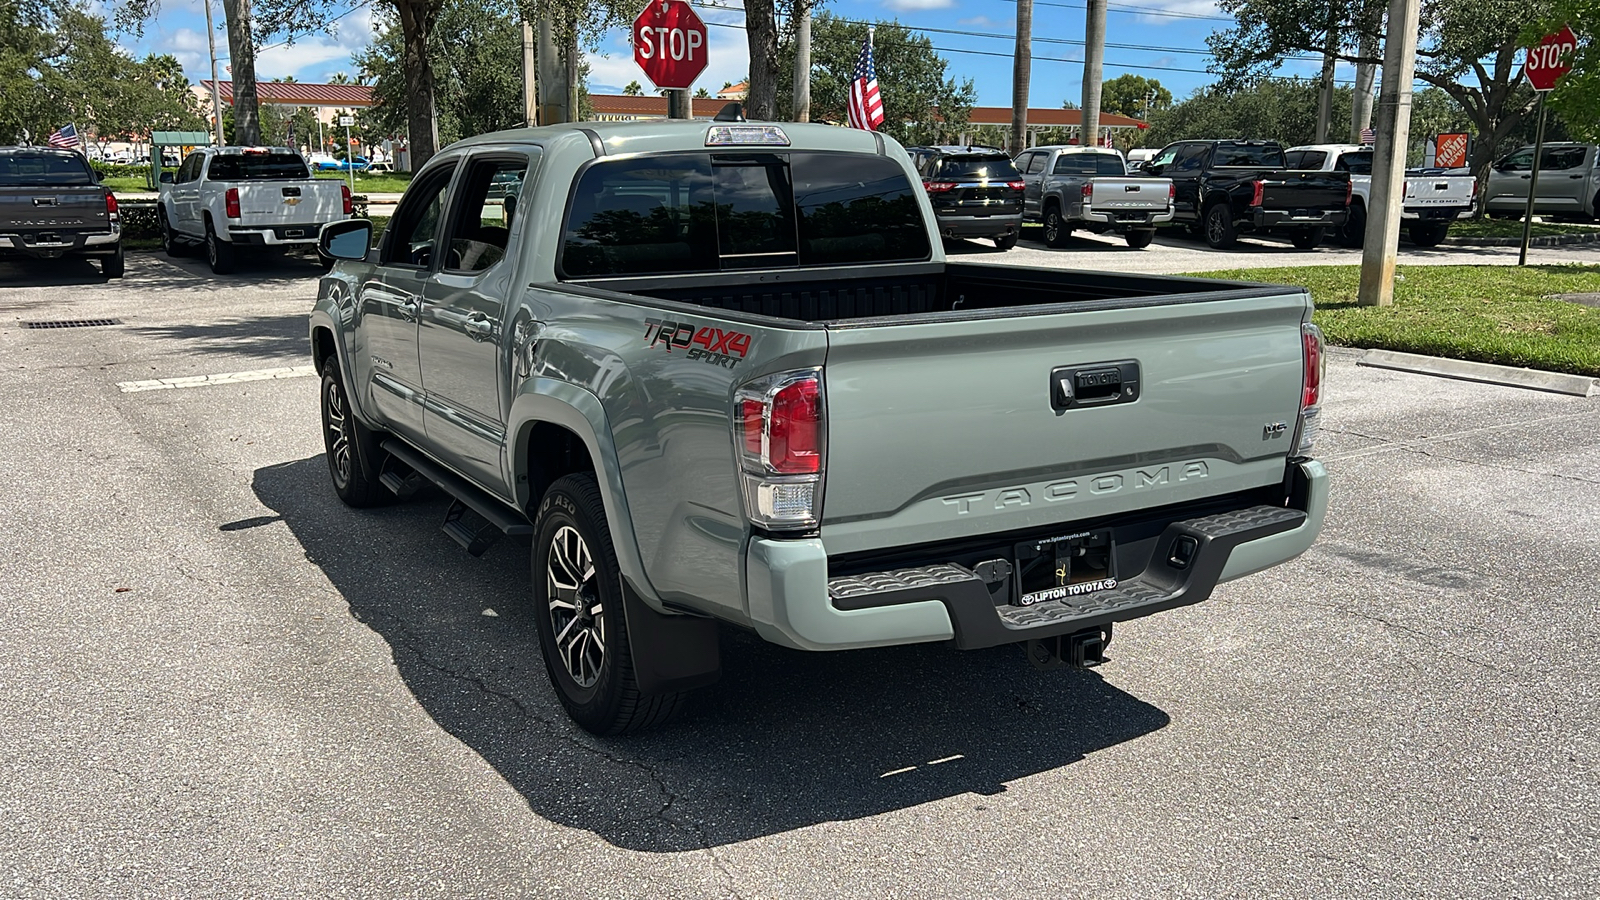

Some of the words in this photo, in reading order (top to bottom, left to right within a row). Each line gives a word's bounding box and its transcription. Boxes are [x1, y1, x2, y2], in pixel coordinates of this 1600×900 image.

[639, 26, 703, 61] STOP
[1529, 43, 1573, 70] STOP
[1436, 134, 1467, 167] HOME
[1440, 138, 1452, 150] THE
[1447, 147, 1466, 167] DEPOT
[644, 317, 695, 353] TRD
[686, 347, 743, 369] SPORT
[1080, 372, 1120, 386] TOYOTA
[1262, 420, 1287, 435] V6
[942, 460, 1209, 515] TACOMA
[1034, 587, 1067, 603] LIPTON
[1068, 581, 1104, 596] TOYOTA
